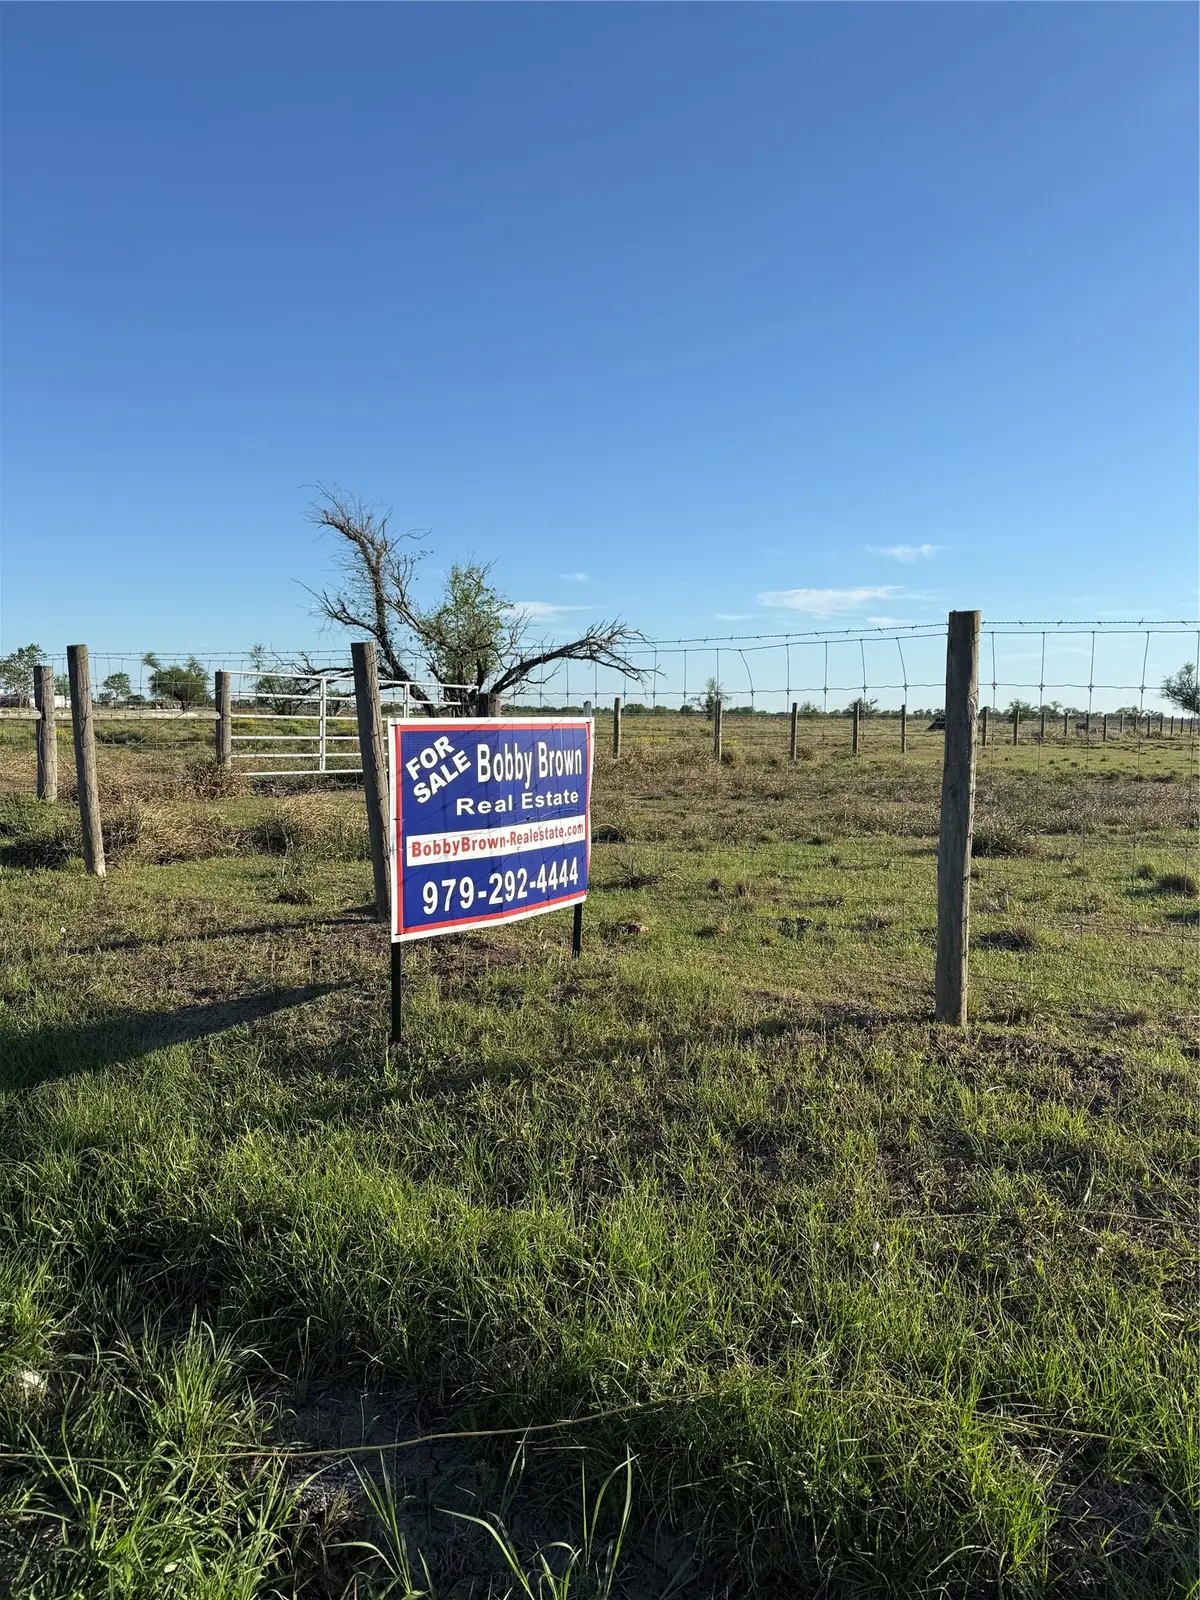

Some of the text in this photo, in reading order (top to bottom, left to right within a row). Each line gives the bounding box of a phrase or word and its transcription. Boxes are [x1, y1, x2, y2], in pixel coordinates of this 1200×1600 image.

[405, 736, 455, 781] FOR
[412, 750, 472, 803] SALE
[477, 742, 582, 789] Bobby Brown
[456, 790, 579, 816] Real Estate
[411, 824, 584, 858] BobbyBrown-Realestate.com
[422, 856, 578, 915] 979-292-4444
